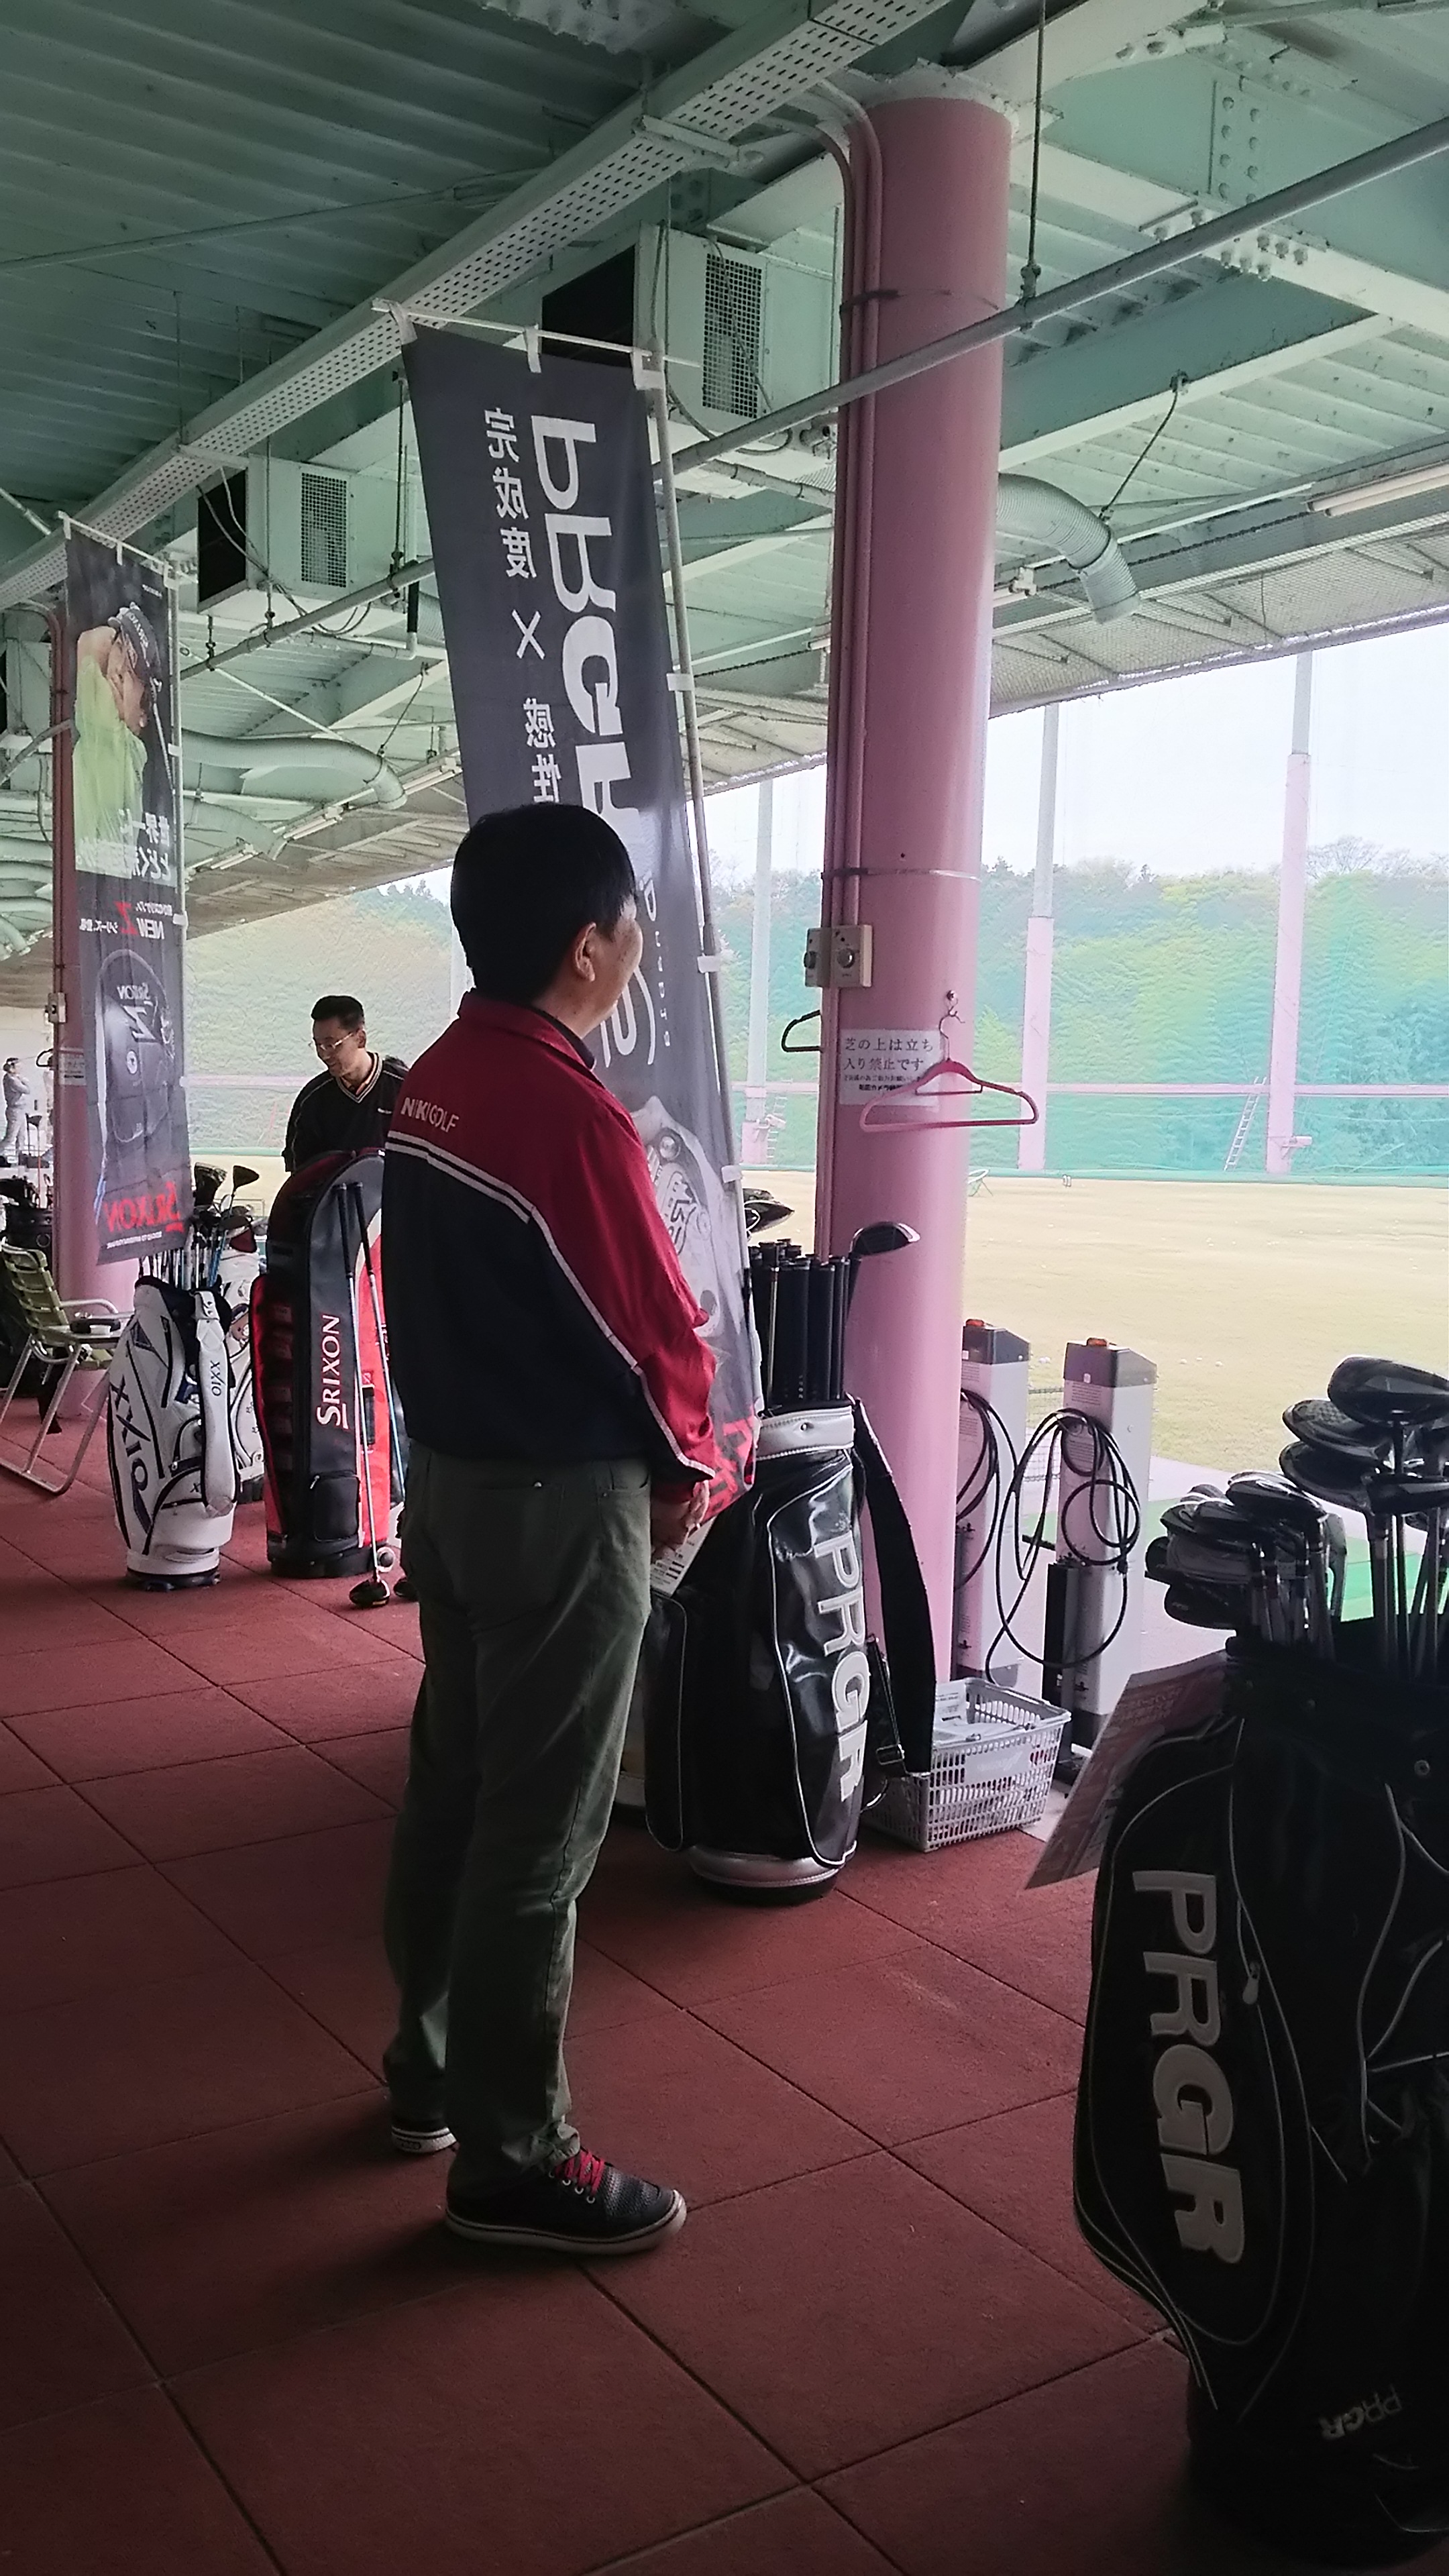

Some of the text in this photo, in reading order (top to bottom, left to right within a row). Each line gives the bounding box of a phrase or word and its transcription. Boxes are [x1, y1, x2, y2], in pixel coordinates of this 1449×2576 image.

[843, 1058, 924, 1071] 入り禁止です
[845, 1038, 933, 1052] 芝の上は立ち
[209, 1360, 223, 1397] XXIO
[315, 1314, 350, 1430] SRIXON
[814, 1530, 871, 1802] PRGR
[1132, 1870, 1246, 2264] PRGR
[1318, 2384, 1403, 2440] PRGR
